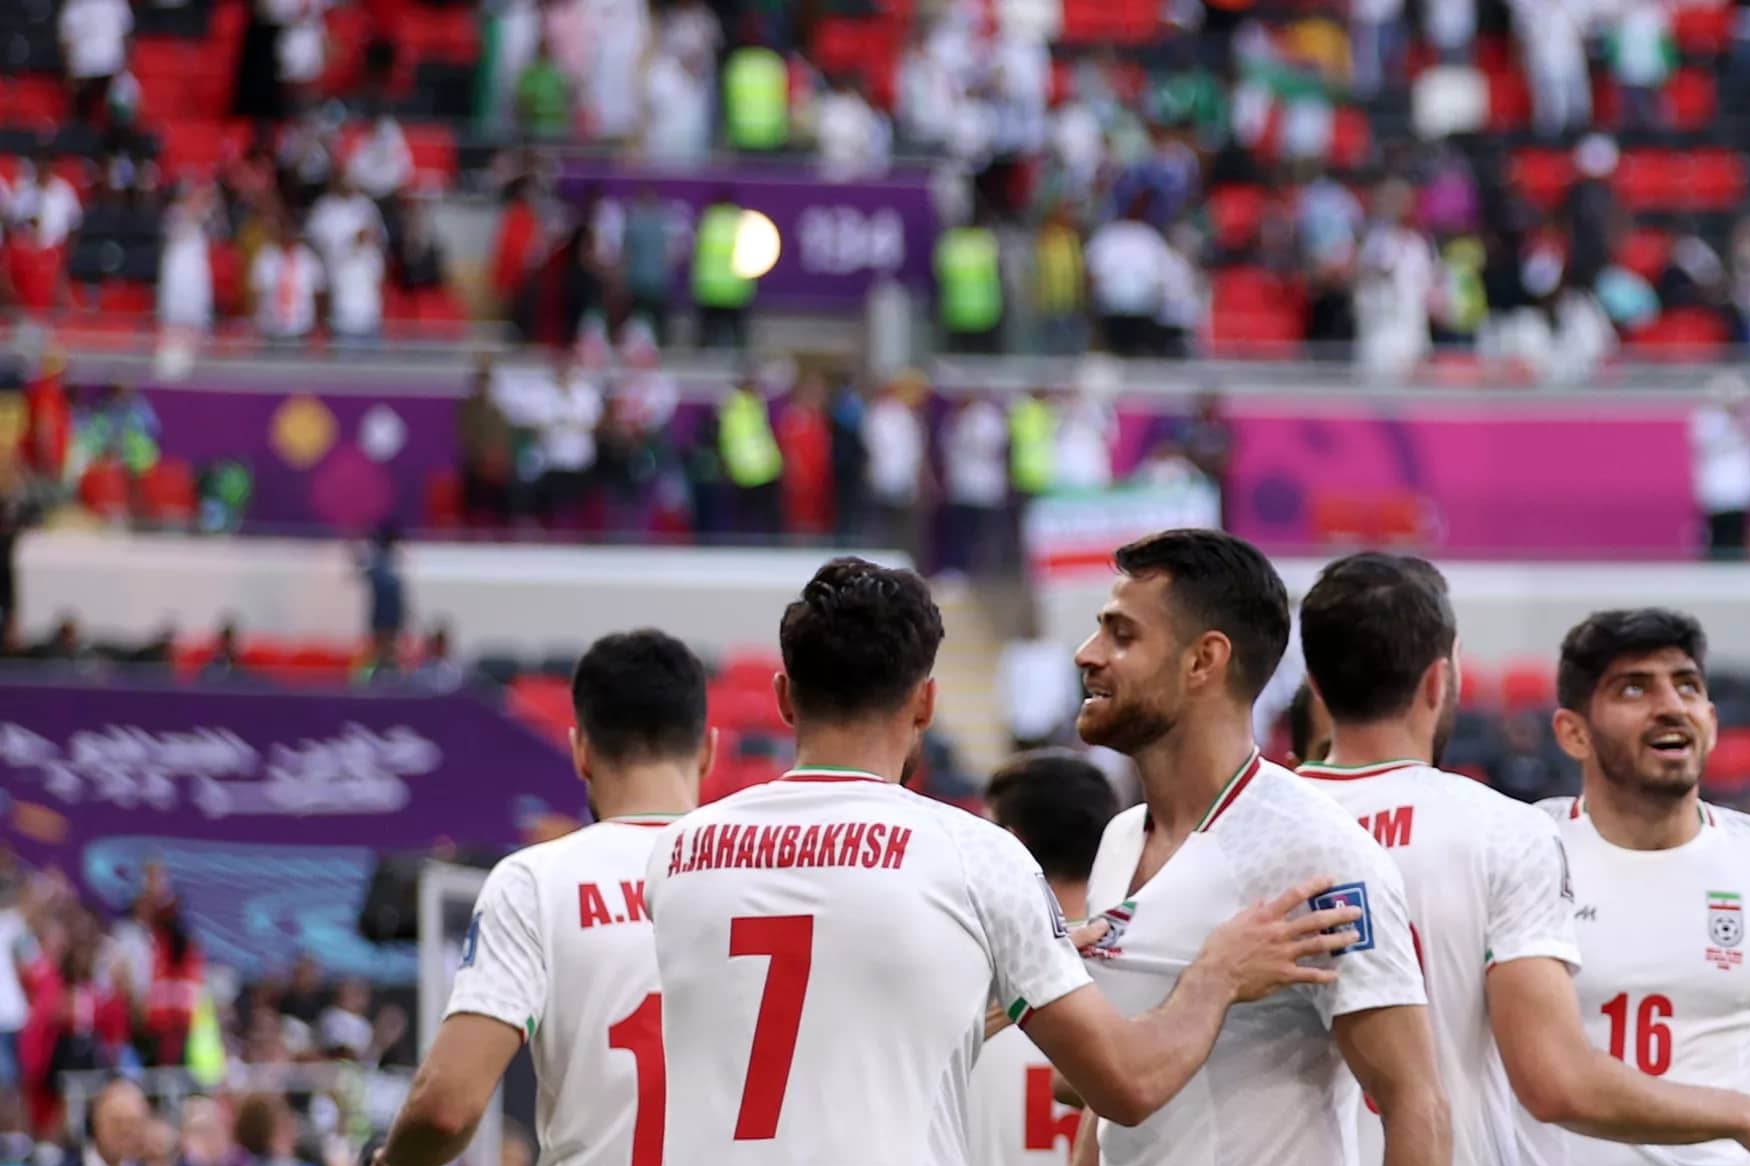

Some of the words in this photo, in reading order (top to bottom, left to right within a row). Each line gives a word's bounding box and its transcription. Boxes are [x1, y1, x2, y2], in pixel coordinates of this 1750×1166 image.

[667, 823, 912, 877] A.JAHANBAKHSH
[729, 914, 814, 1141] 7
[1600, 992, 1674, 1077] 16
